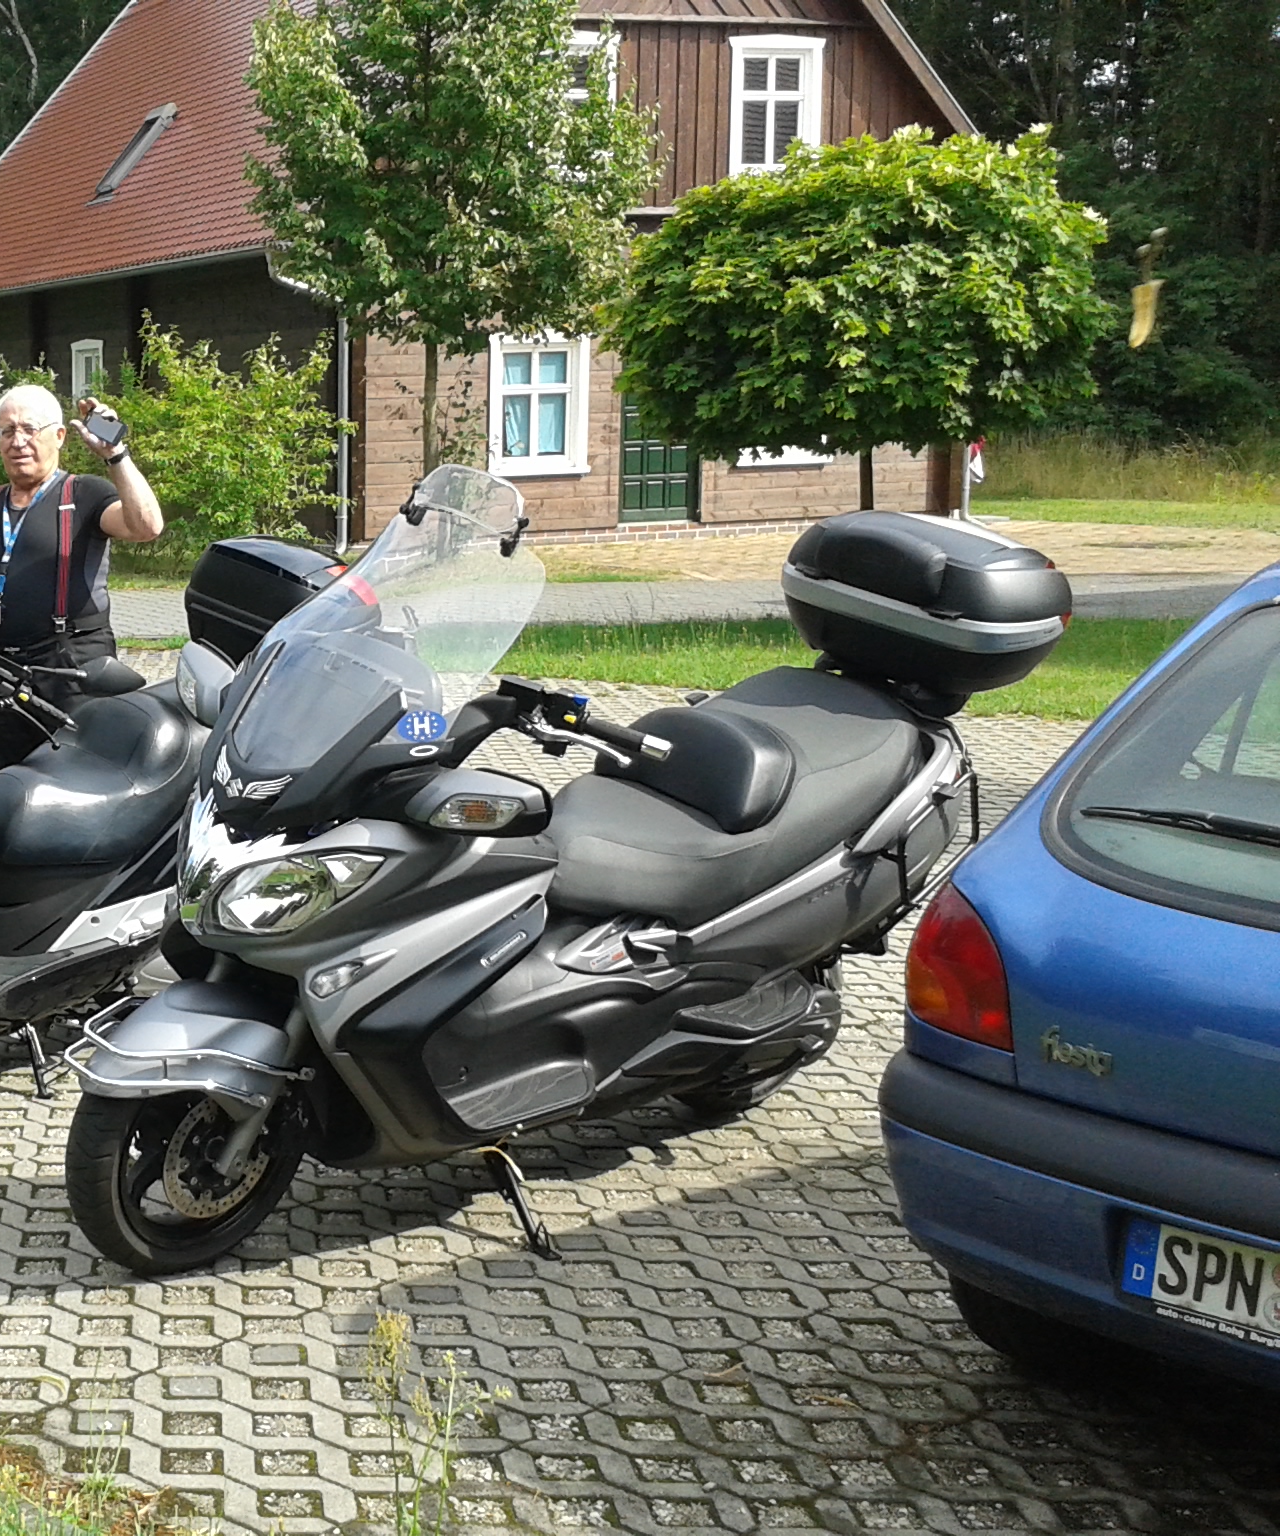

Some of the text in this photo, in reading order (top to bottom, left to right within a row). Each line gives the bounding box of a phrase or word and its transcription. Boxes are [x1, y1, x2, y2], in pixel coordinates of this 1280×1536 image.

[413, 716, 431, 735] H
[1132, 1263, 1145, 1281] D
[1158, 1235, 1264, 1317] SPN
